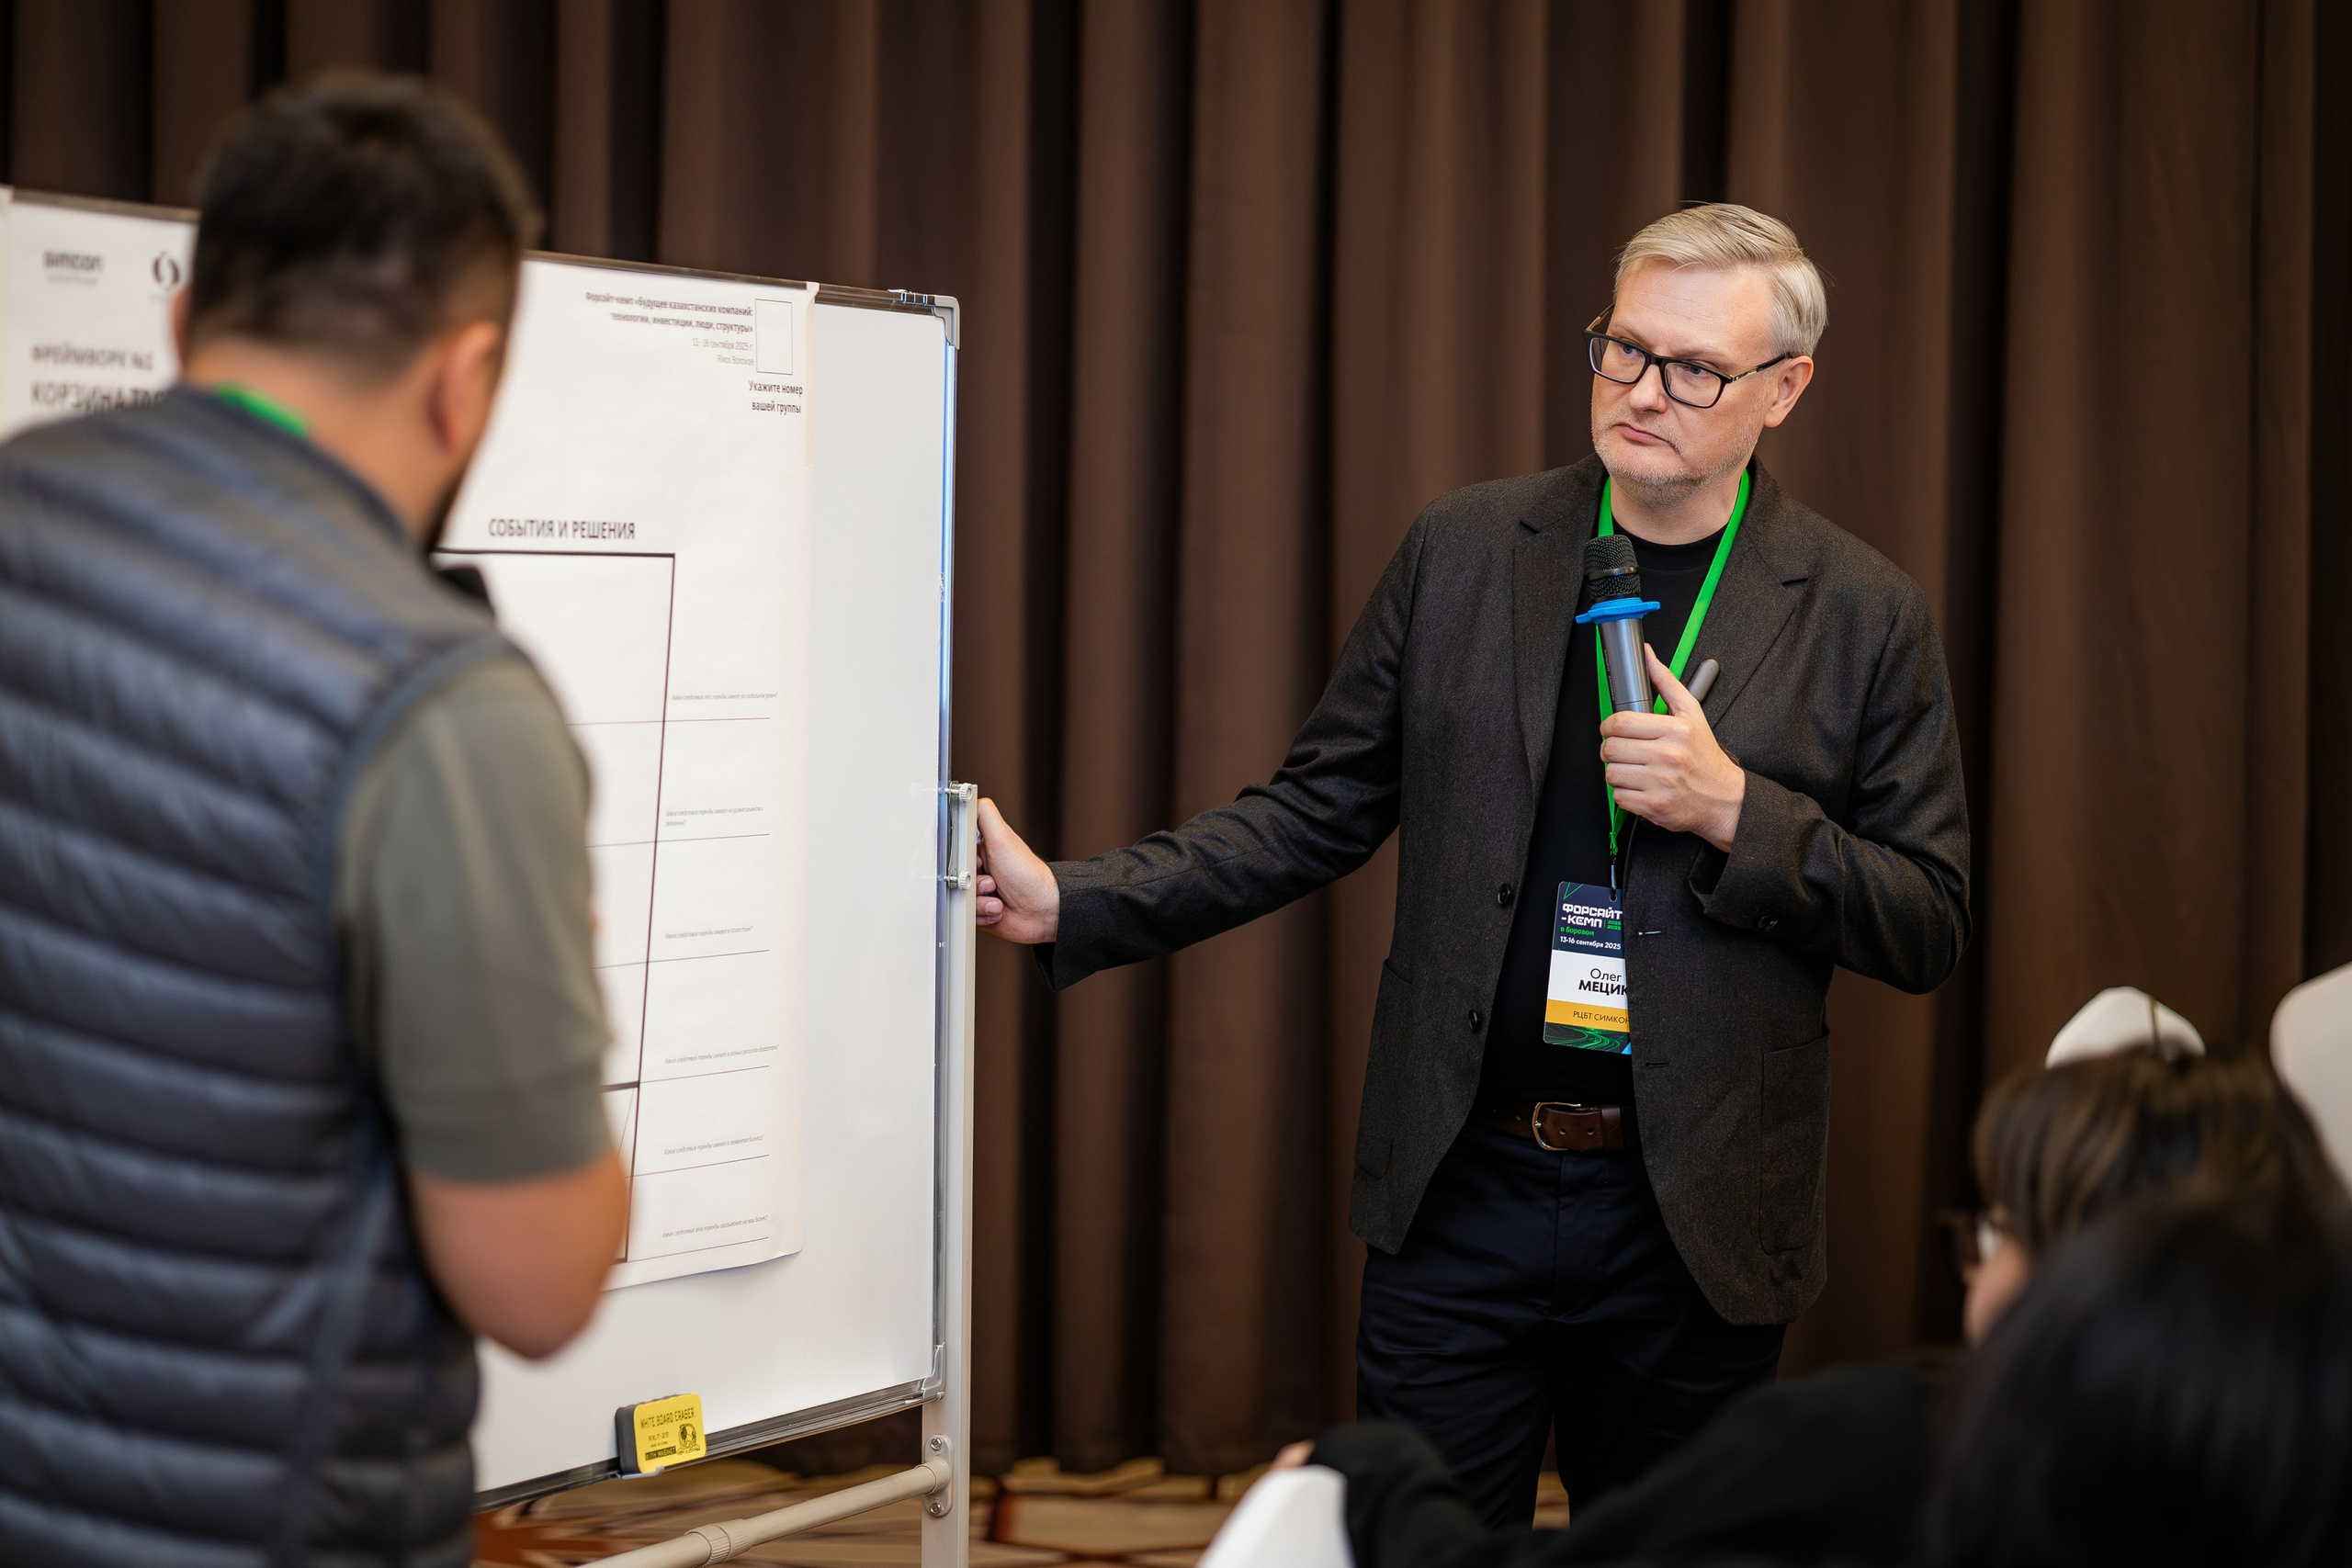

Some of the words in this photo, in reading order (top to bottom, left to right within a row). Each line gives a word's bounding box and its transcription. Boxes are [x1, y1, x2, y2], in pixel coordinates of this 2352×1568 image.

[585, 292, 634, 305] Форсайт-кемп
[669, 301, 717, 313] казахстанских
[610, 312, 651, 325] технологии,
[652, 317, 695, 329] инвестиции,
[695, 321, 715, 331] люди,
[735, 341, 749, 350] 2025
[748, 380, 780, 393] Укажите
[782, 385, 803, 397] номер
[752, 400, 775, 412] вашей
[777, 404, 802, 416] группы
[488, 519, 554, 537] СОБЫТИЯ
[558, 519, 568, 537] И
[572, 521, 635, 539] РЕШЕНИЯ
[1562, 903, 1623, 919] ФОРСАЙТ
[1561, 915, 1602, 928] -КЕМП
[1566, 926, 1594, 936] Боровом
[1576, 939, 1604, 948] сентября
[1590, 968, 1622, 982] Олег
[1573, 1011, 1593, 1020] РЦБТ
[656, 1412, 673, 1425] BOARD
[675, 1407, 695, 1422] ERASER
